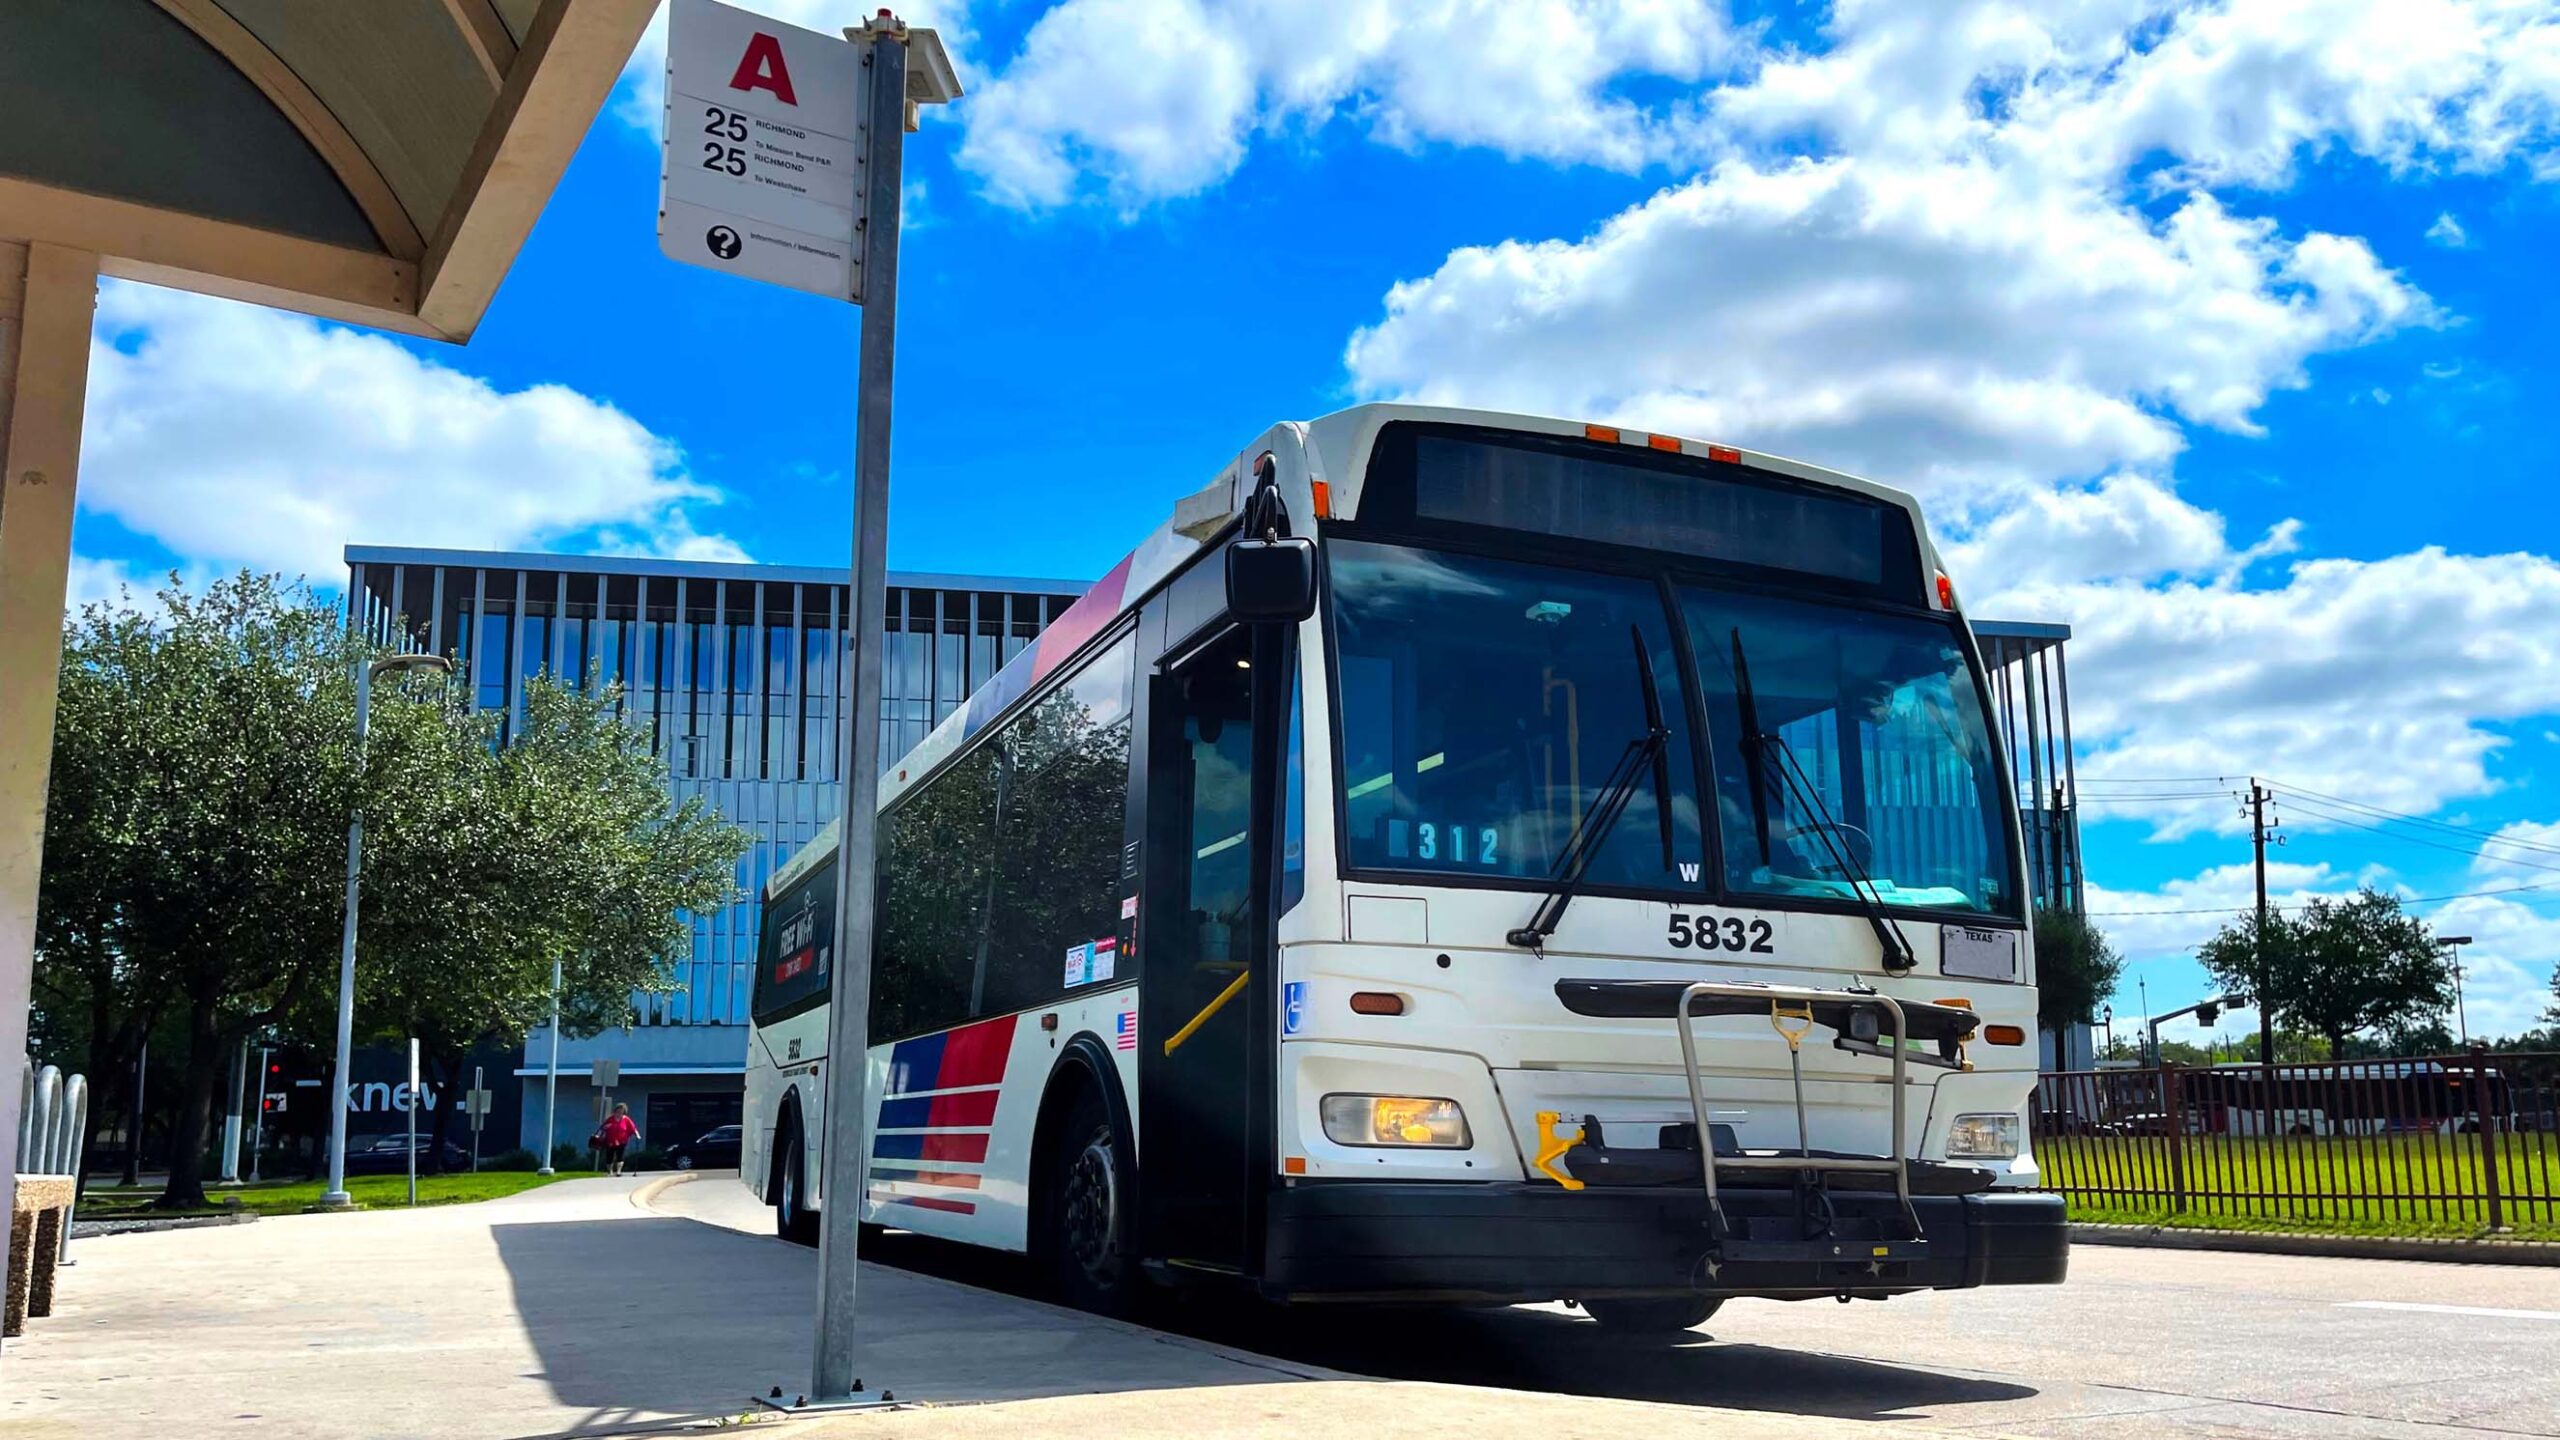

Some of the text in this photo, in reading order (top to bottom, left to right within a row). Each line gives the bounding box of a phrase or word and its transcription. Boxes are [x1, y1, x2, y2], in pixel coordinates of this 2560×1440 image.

[729, 31, 798, 106] A
[704, 107, 806, 142] 25 RICHMOND
[703, 142, 805, 176] 25 RICHMOND
[756, 140, 764, 149] To
[755, 174, 763, 182] To
[1679, 863, 1699, 882] W
[779, 923, 796, 958] FREE
[1668, 913, 1774, 954] 5832
[1965, 931, 1993, 943] TEXAS
